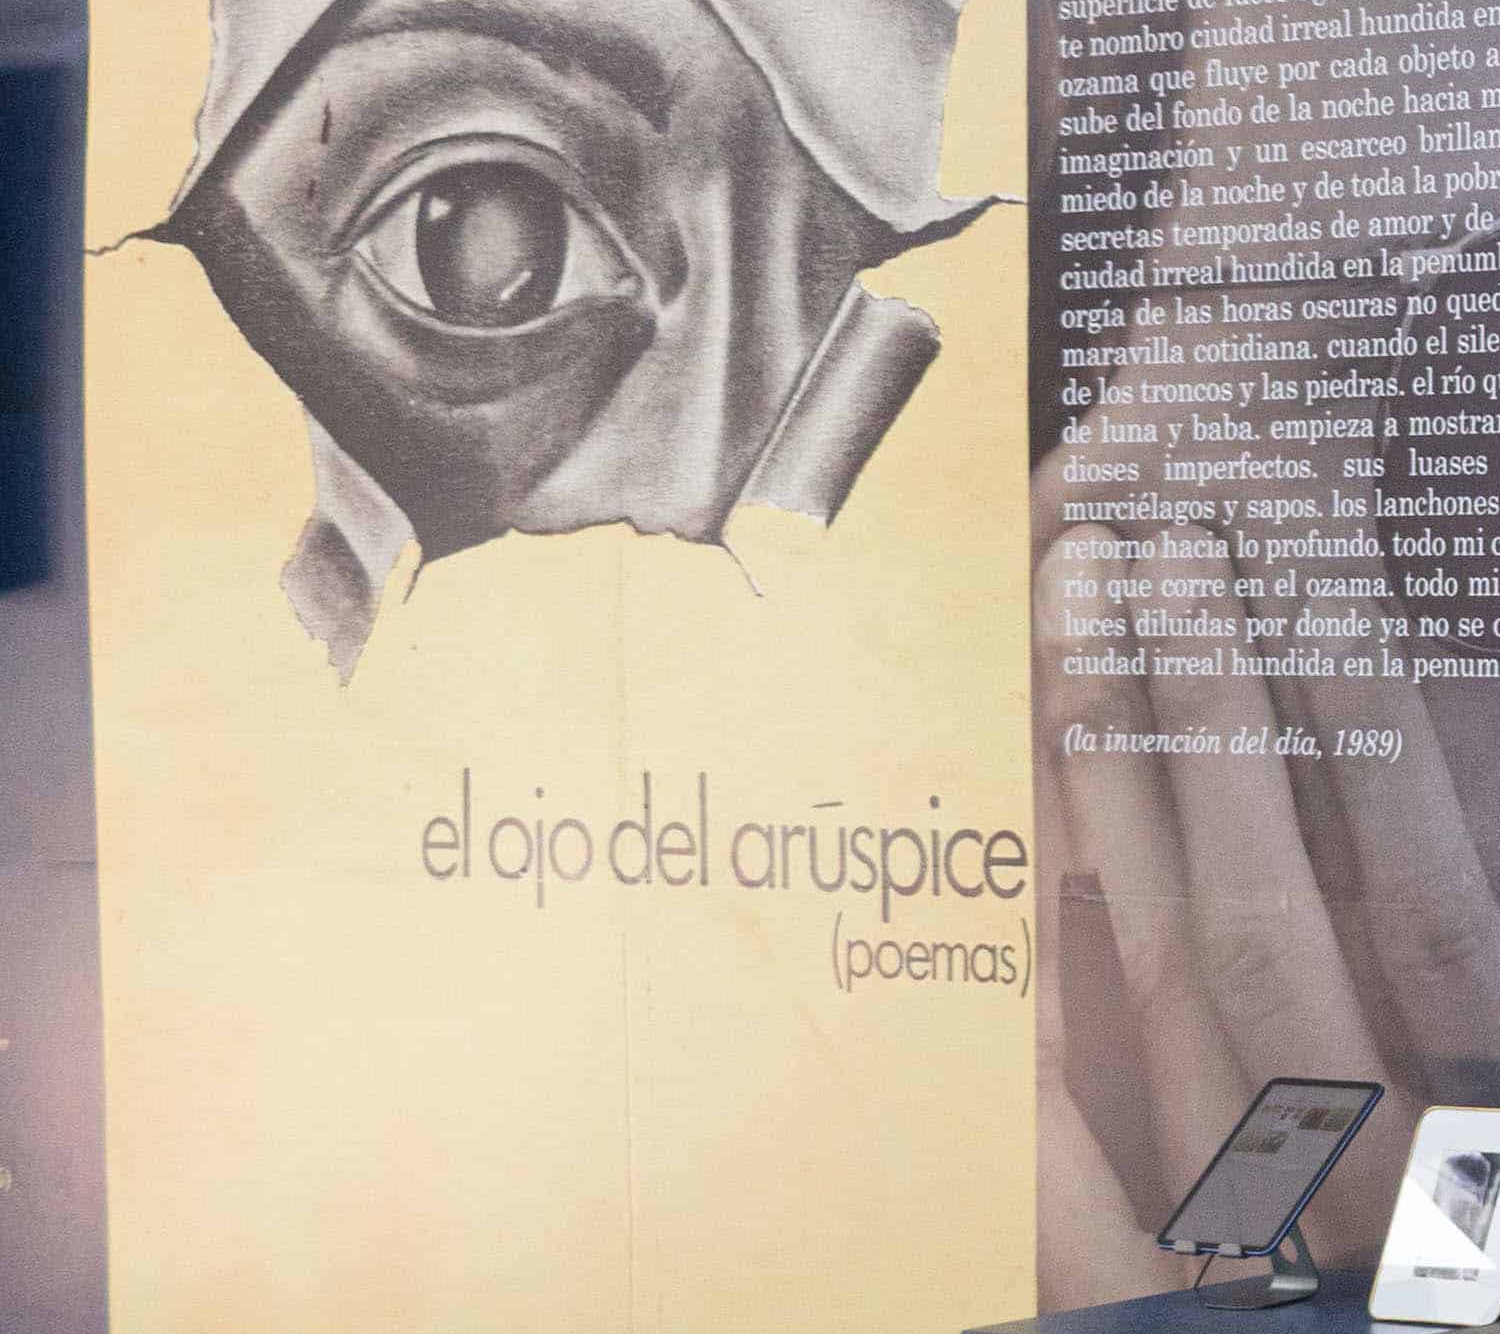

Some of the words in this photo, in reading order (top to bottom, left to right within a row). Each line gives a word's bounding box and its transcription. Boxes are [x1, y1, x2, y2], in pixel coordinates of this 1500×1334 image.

[1062, 646, 1146, 677] ciudad
[1153, 646, 1224, 677] irreal
[1230, 646, 1337, 678] hundida
[1342, 656, 1375, 679] en
[1380, 647, 1406, 679] la
[1064, 723, 1099, 758] (la
[1103, 726, 1223, 756] invención
[1229, 726, 1268, 756] del
[1274, 726, 1322, 761] día,
[1333, 728, 1404, 765] 1989)
[421, 766, 472, 882] el
[488, 785, 594, 910] ojo
[607, 769, 710, 889] del
[831, 910, 1032, 999] (poemas)
